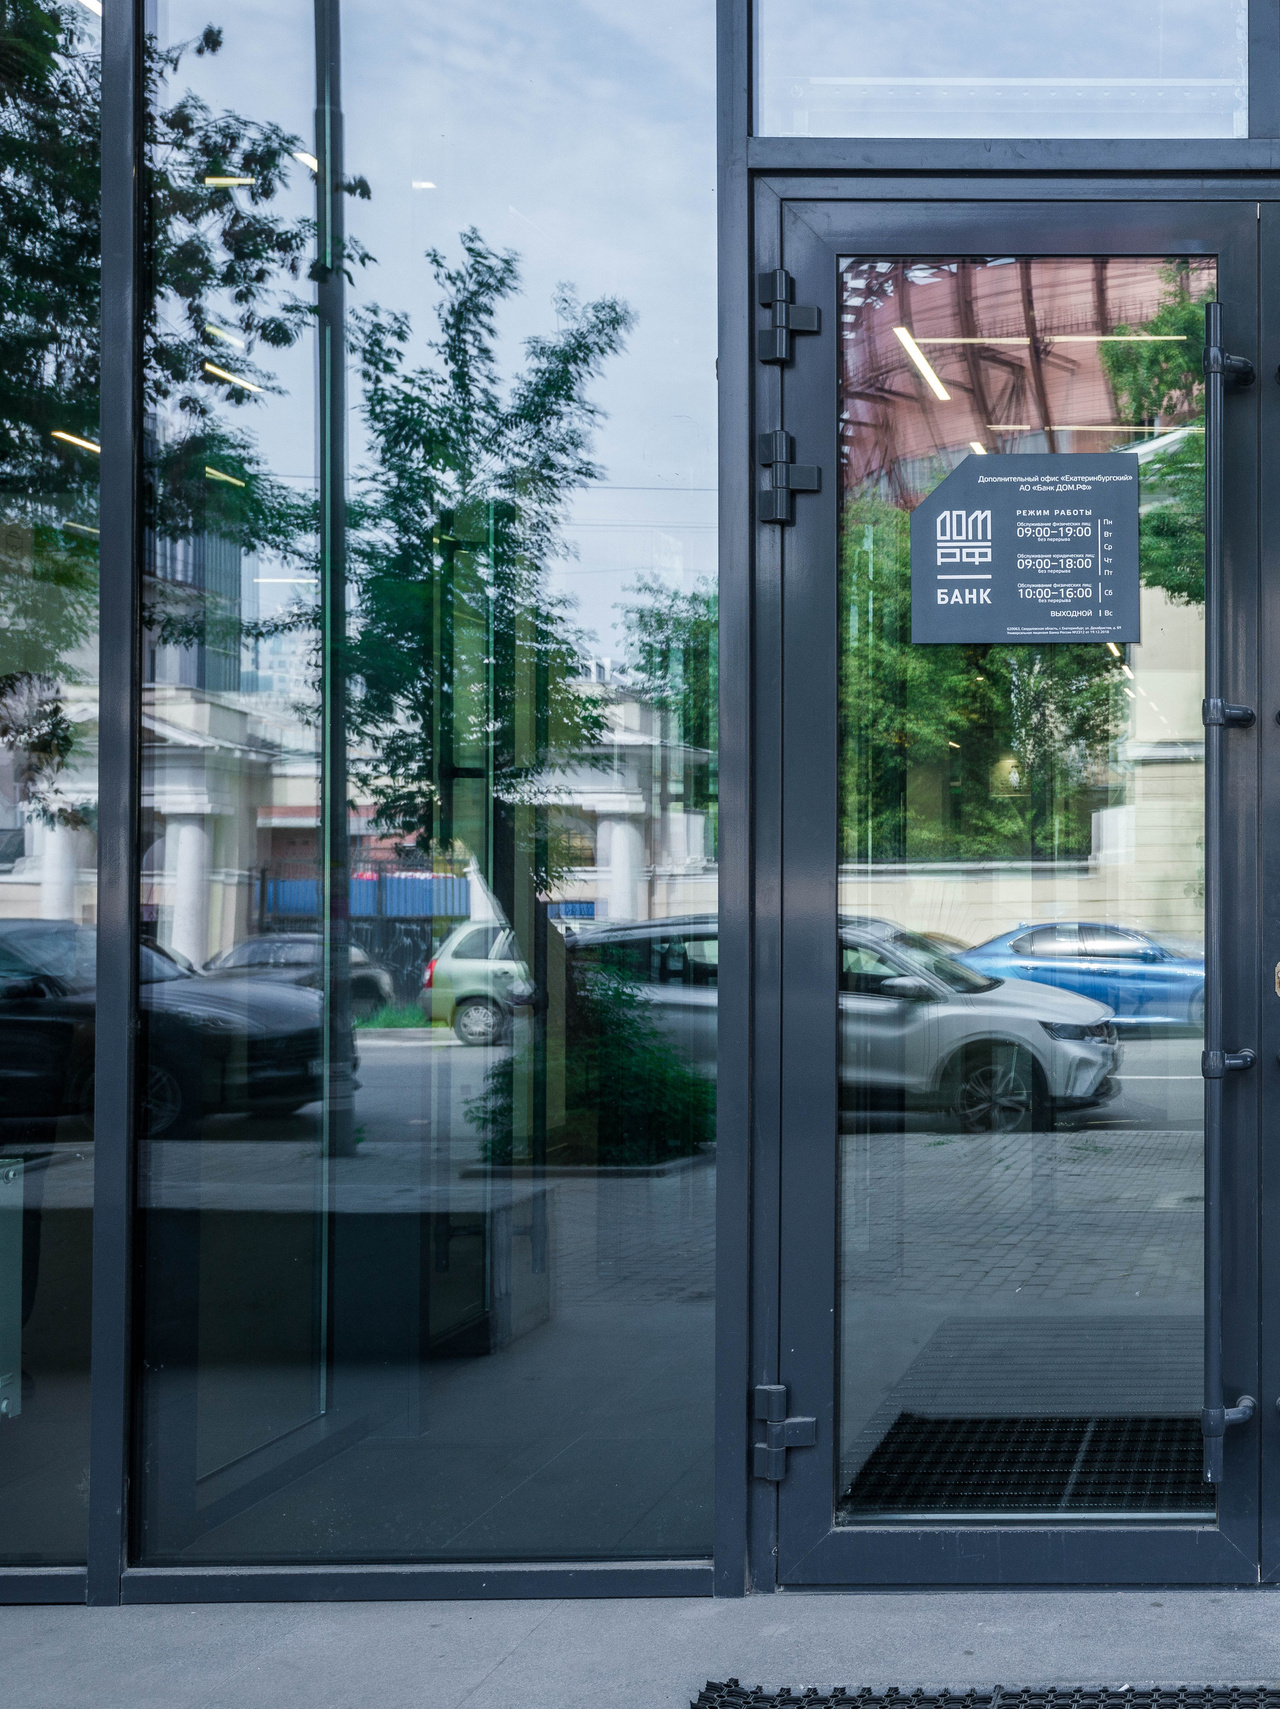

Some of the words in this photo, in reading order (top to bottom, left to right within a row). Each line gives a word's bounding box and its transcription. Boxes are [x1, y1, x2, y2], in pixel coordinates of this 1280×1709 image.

[978, 475, 1039, 484] Дополнительный
[1040, 475, 1059, 483] офис
[1060, 474, 1133, 482] «Екатеринбургский»
[936, 510, 992, 540] ДОМ
[936, 548, 992, 565] РФ
[937, 588, 992, 604] БАНК
